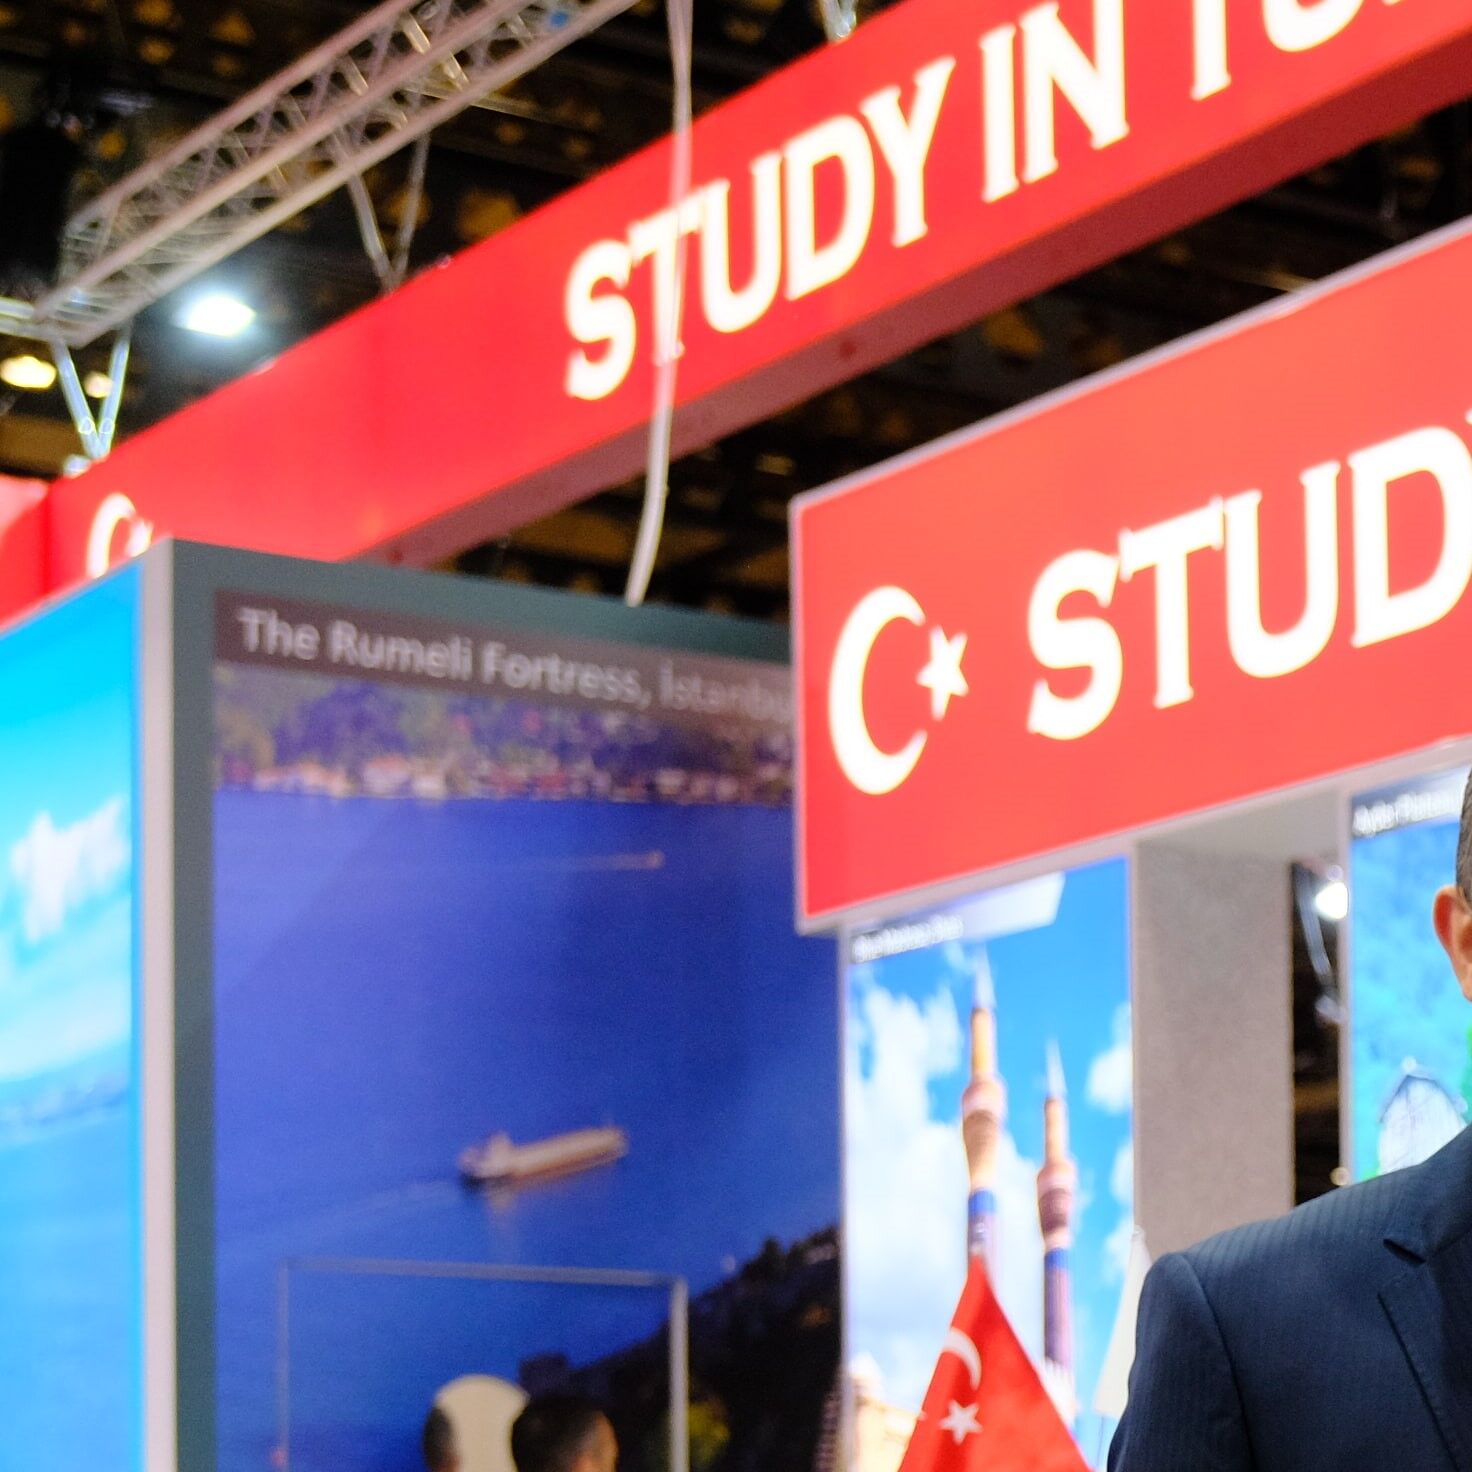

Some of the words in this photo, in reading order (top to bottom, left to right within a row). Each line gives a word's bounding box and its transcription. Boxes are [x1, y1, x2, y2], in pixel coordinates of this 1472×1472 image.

[563, 56, 954, 400] STUDY
[980, 0, 1128, 203] IN
[237, 606, 320, 661] The
[326, 620, 471, 683] Rumeli
[480, 641, 651, 709] Fortress,
